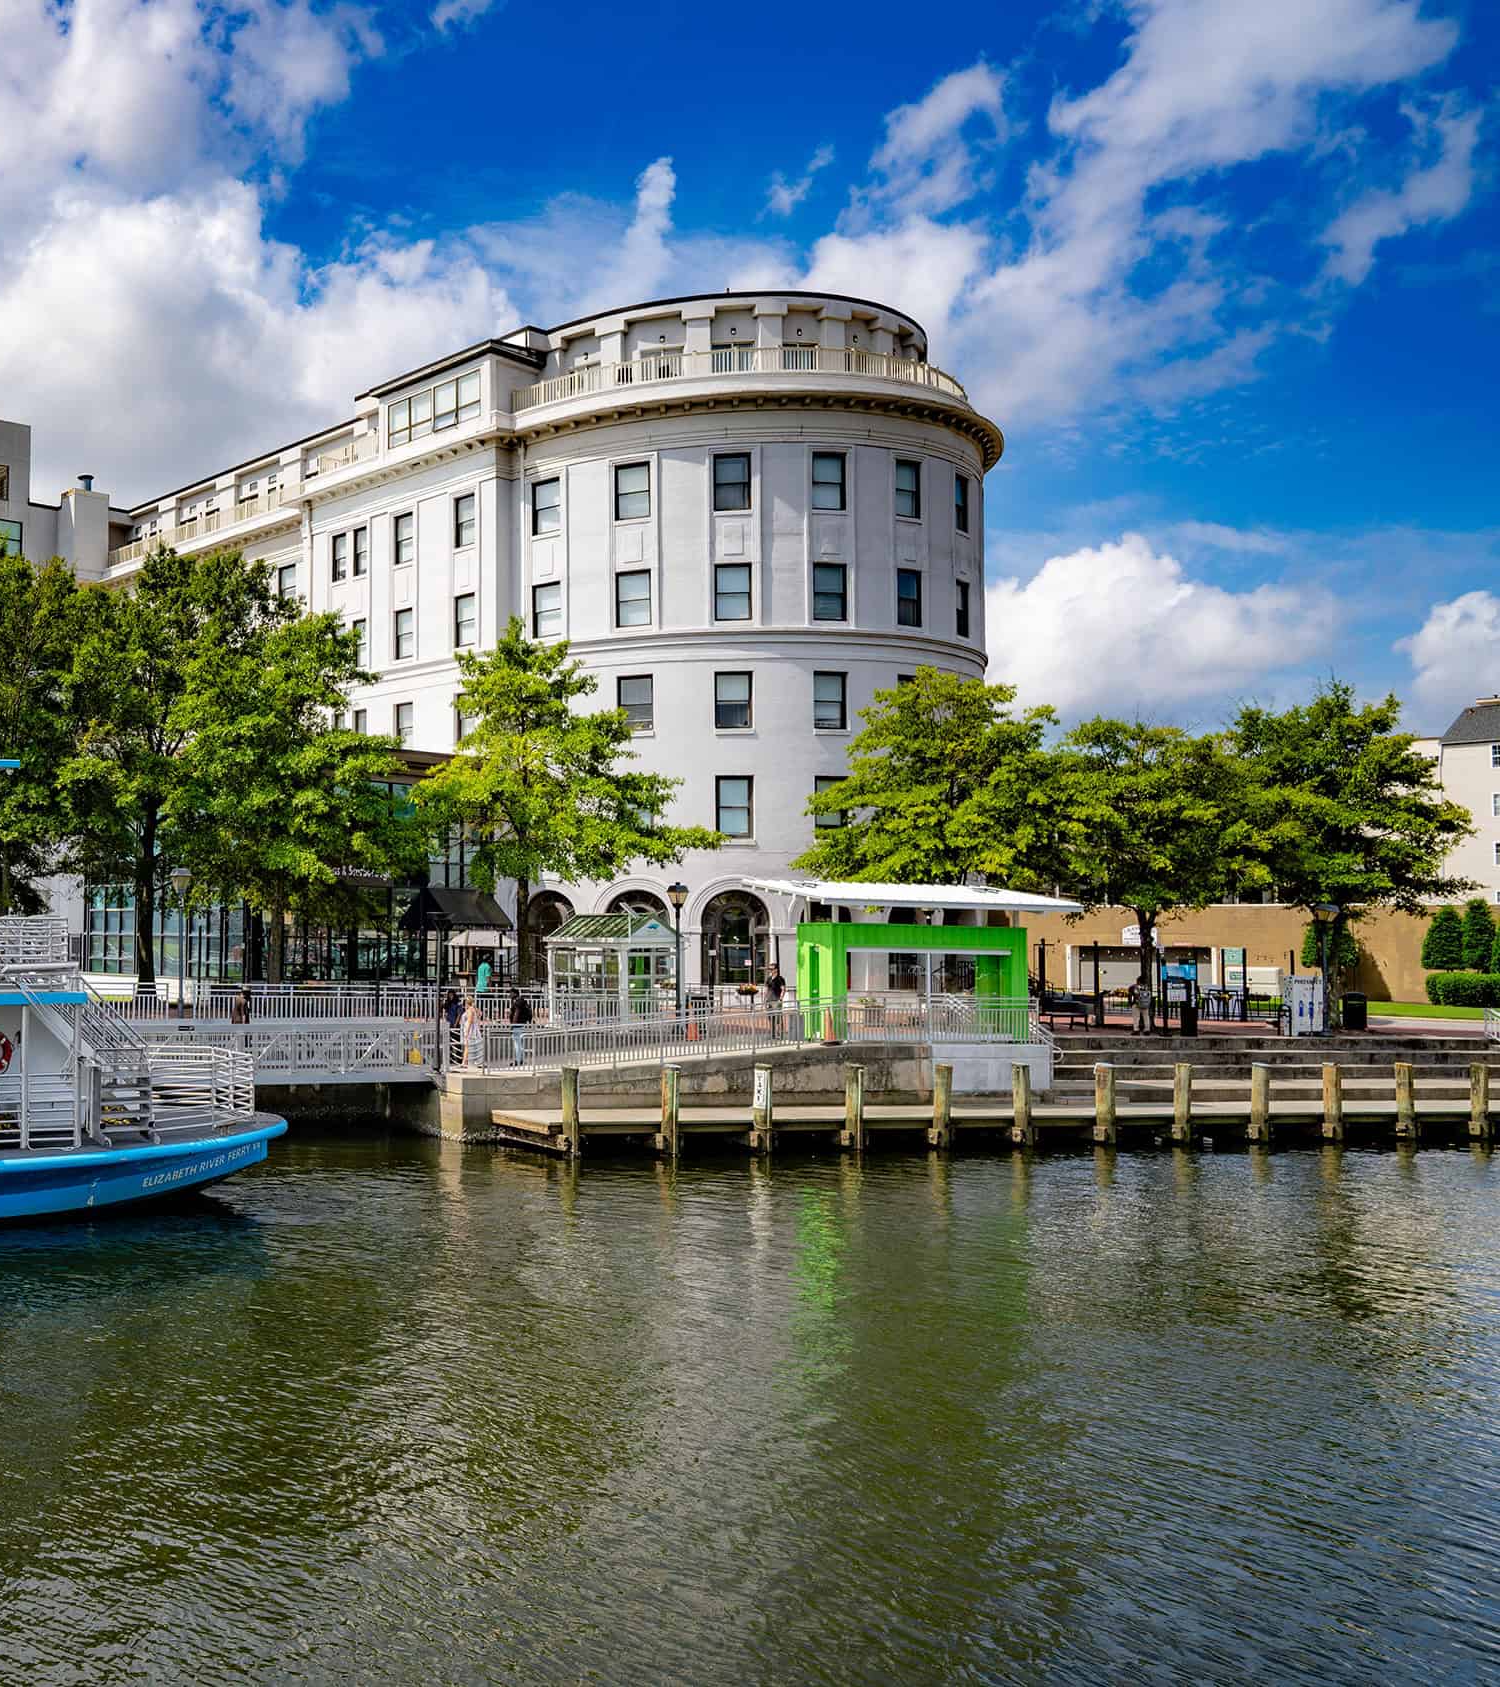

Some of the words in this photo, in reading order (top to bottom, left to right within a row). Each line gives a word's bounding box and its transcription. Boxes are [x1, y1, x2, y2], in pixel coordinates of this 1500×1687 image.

[142, 1165, 197, 1187] ELIZABETH
[199, 1154, 225, 1172] RIVER
[228, 1143, 251, 1161] FERRY
